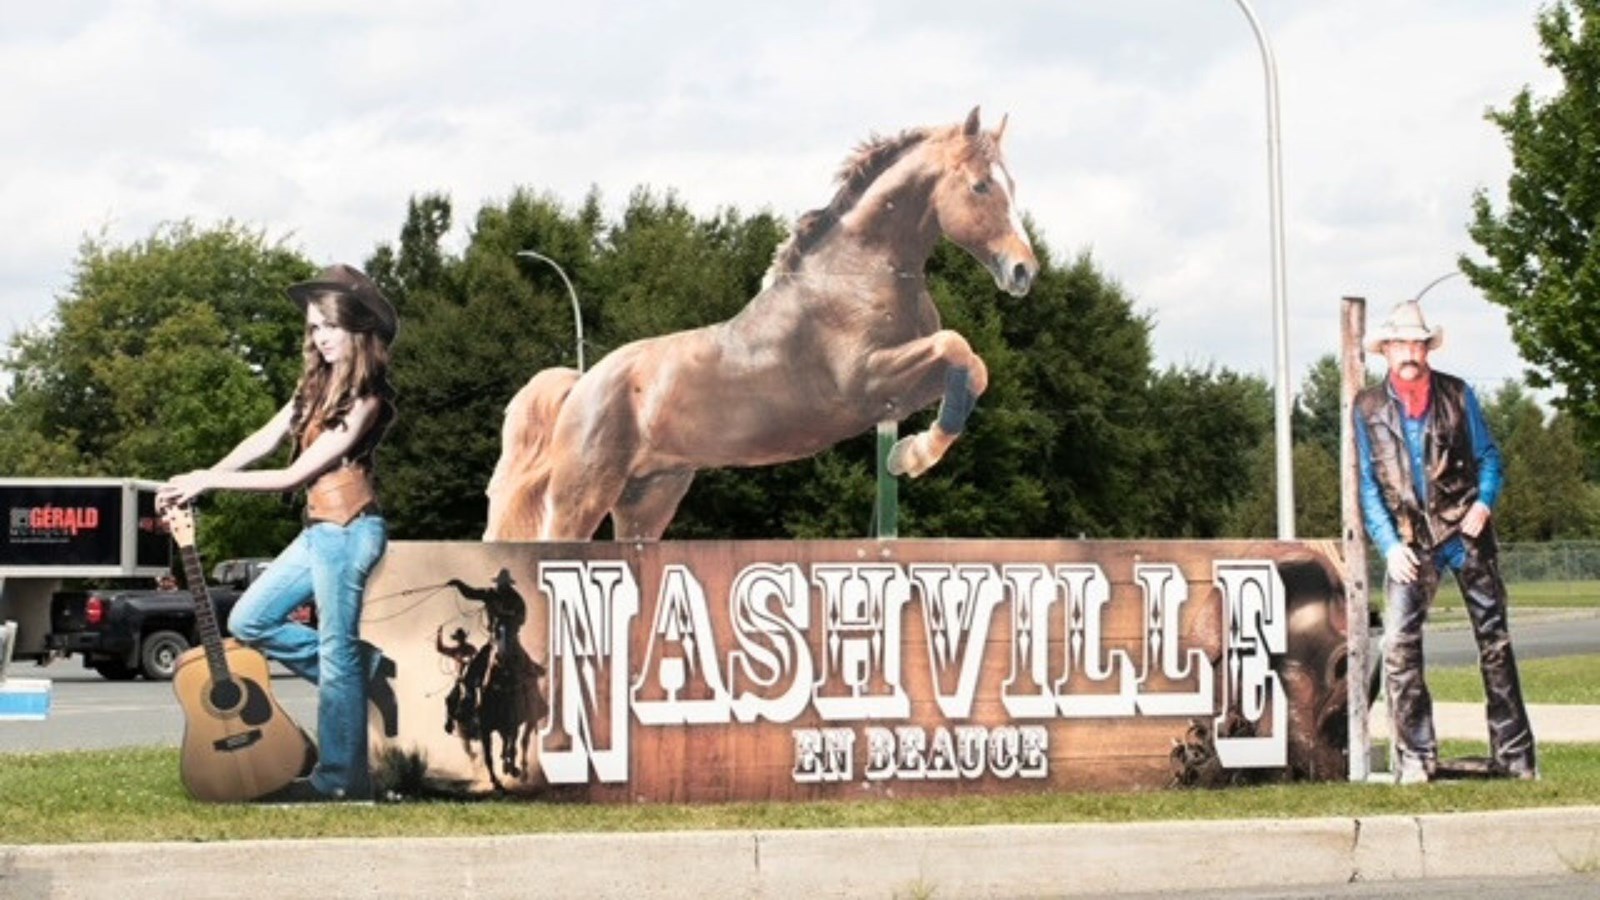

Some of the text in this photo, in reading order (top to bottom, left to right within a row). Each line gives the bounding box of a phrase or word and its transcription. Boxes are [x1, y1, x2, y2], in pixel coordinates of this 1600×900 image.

[30, 503, 98, 535] GÉRALD
[538, 559, 1288, 785] NASHVILLE
[792, 725, 1048, 782] EN BEAUCE
